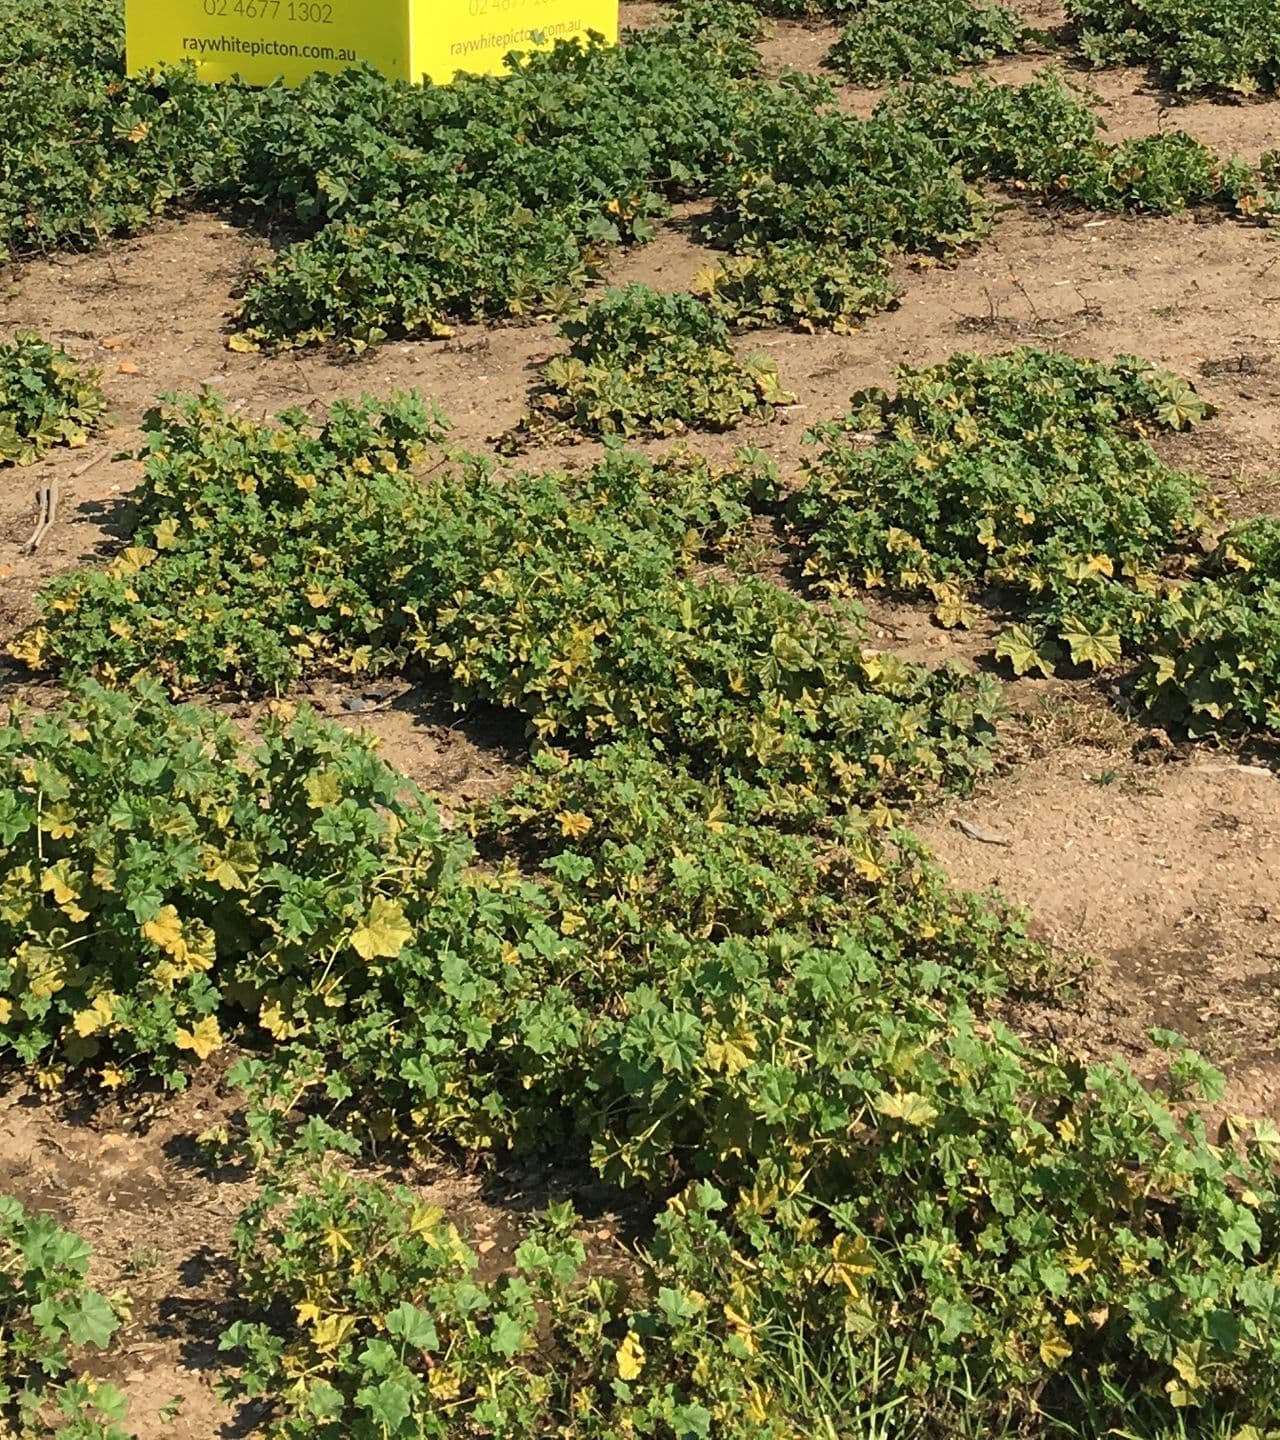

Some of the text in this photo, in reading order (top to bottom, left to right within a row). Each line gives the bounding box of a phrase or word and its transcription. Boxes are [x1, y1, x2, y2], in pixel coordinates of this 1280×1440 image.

[287, 2, 333, 24] 1302
[182, 35, 356, 61] raywhitepicton.com.au
[450, 19, 581, 56] raywhitepictocom.au
